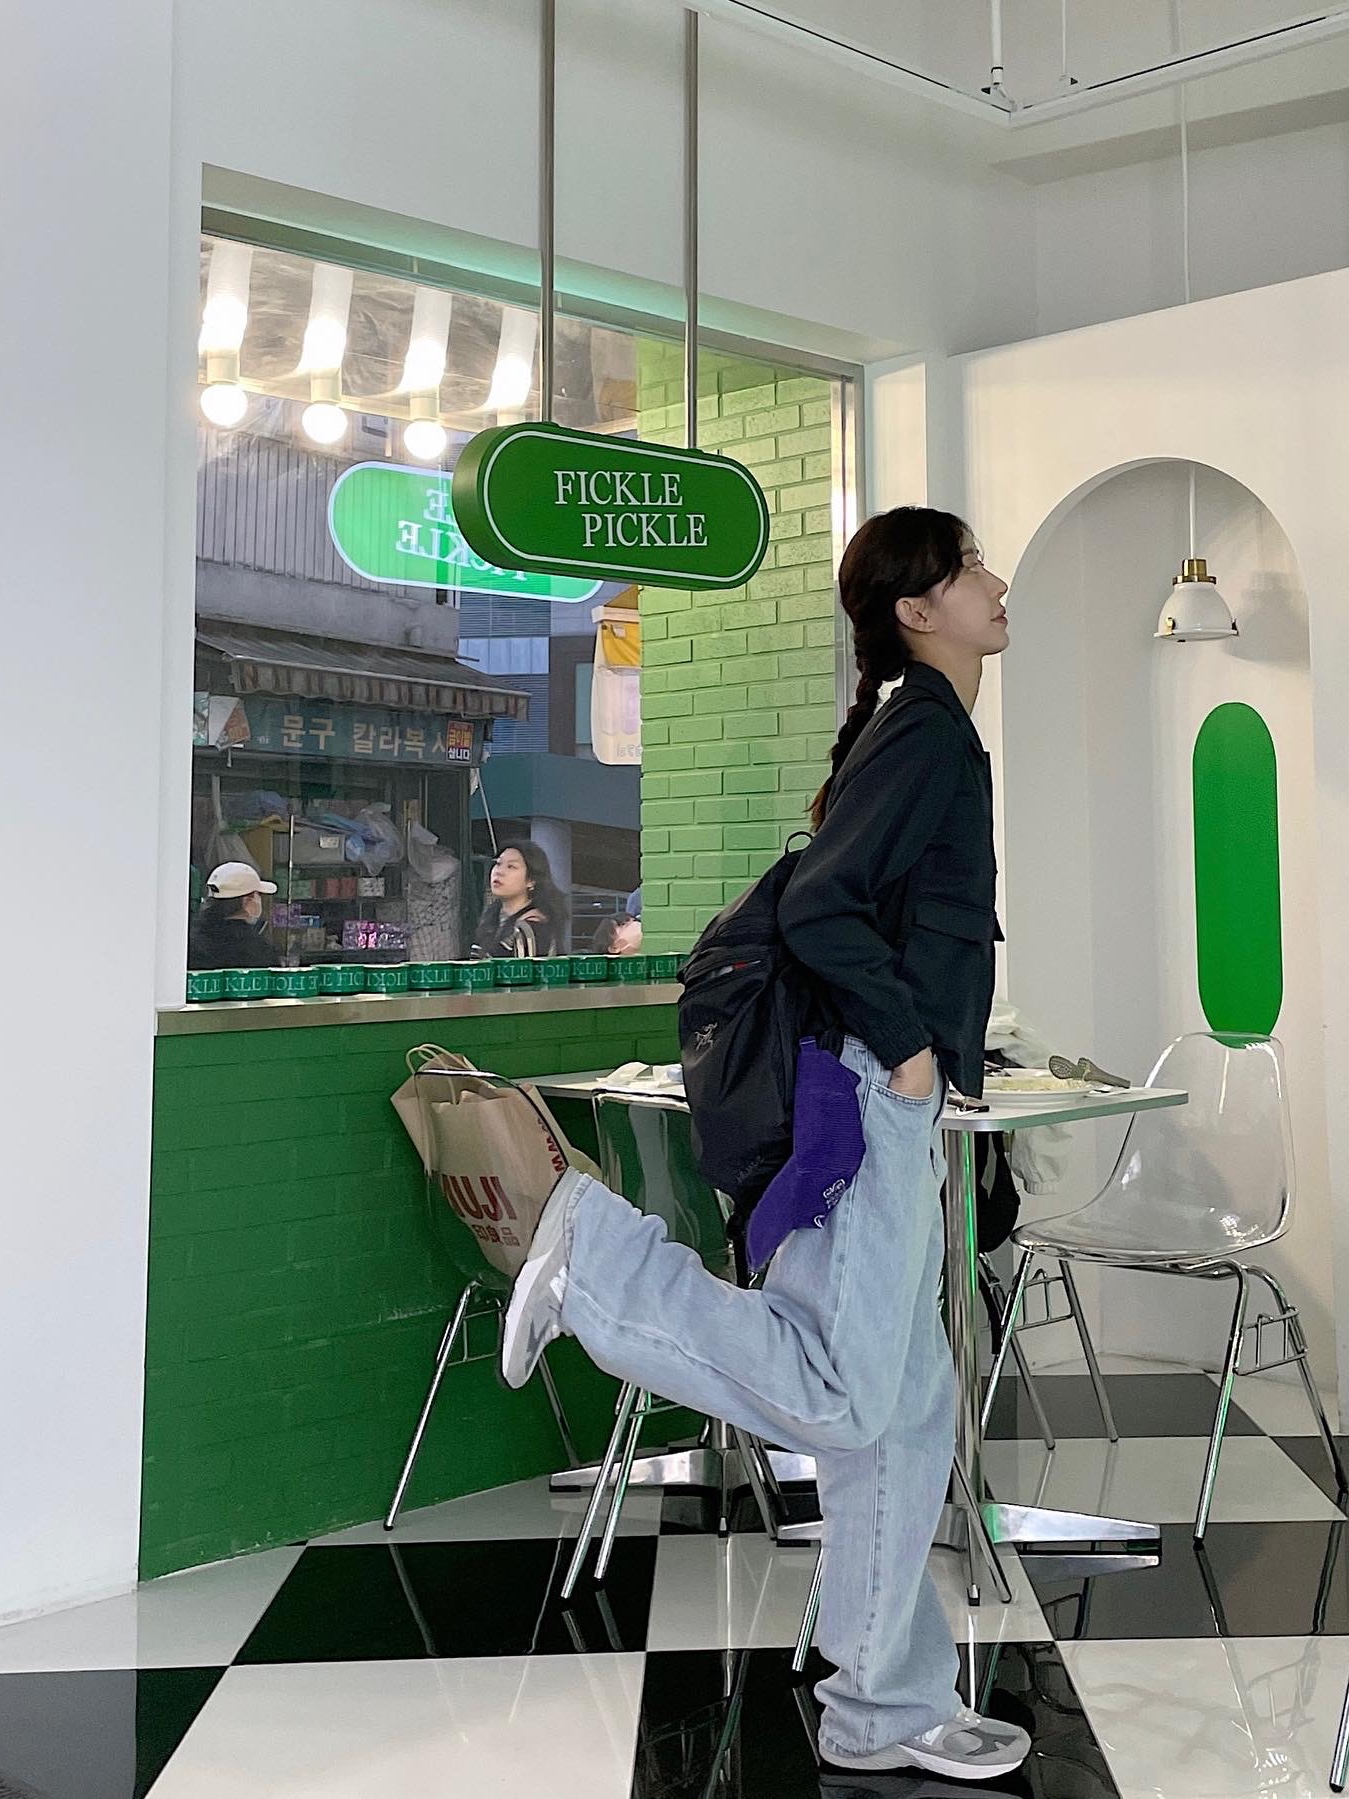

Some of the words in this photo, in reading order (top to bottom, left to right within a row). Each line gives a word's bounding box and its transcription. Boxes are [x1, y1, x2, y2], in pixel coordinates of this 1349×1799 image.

[553, 470, 683, 506] FICKLE
[582, 513, 708, 547] PICKLE
[282, 714, 336, 750] 문구
